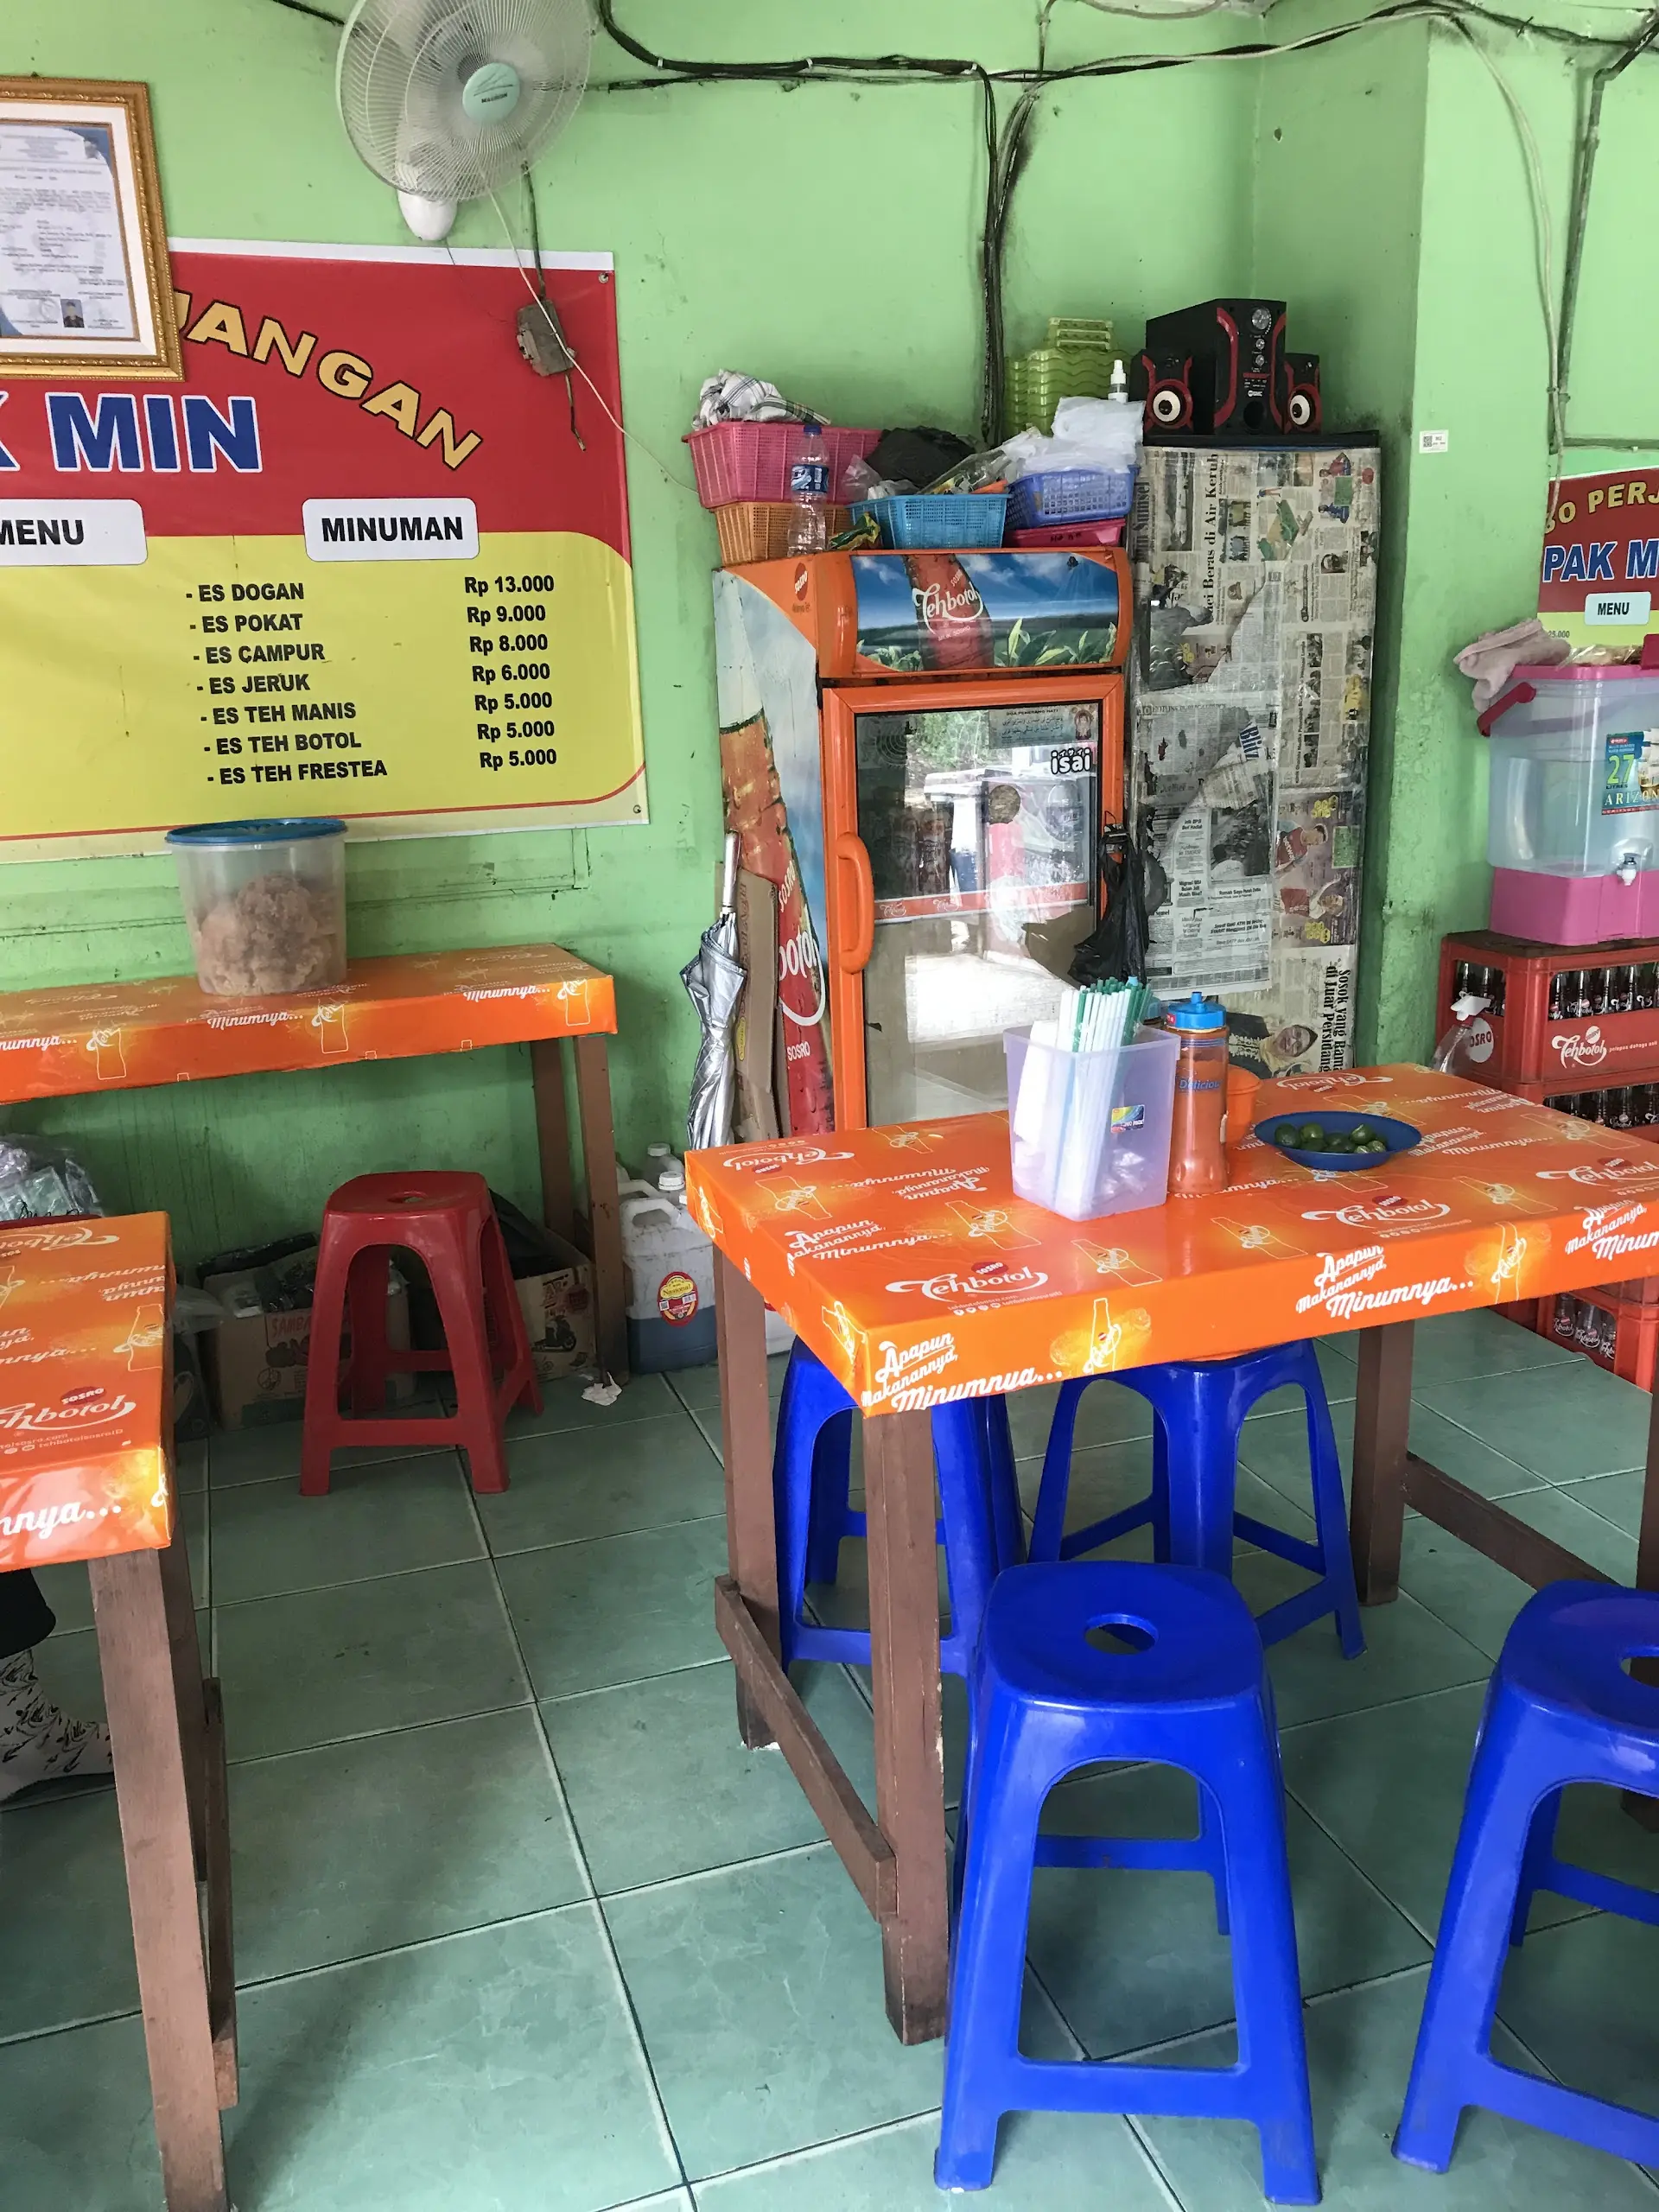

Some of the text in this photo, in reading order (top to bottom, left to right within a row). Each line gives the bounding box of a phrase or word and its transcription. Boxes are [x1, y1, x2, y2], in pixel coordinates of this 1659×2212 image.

[45, 391, 264, 473] MIN
[1205, 453, 1219, 499] Keruh
[1205, 503, 1217, 528] Air
[321, 516, 463, 543] MINUMAN
[1205, 531, 1217, 545] di
[1202, 549, 1216, 590] Beras
[1541, 540, 1618, 583] PAK
[198, 582, 304, 602] ES DOGAN
[466, 575, 555, 596] Rp 13.000
[467, 605, 546, 626] Rp 9.000
[1597, 601, 1630, 616] MENU
[202, 613, 303, 632] ES POKAT
[206, 643, 325, 664] ES CAMPUR
[469, 633, 548, 656] Rp 8.000
[209, 674, 310, 694] ES JERUK
[472, 663, 550, 685] Rp 6.000
[213, 702, 357, 724] ES TEH MANIS
[474, 691, 552, 714] Rp 5.000
[217, 732, 361, 754] ES TEH BOTOL
[477, 721, 555, 742] Rp 5.000
[1239, 726, 1263, 760] Blitz
[480, 748, 556, 771] Rp 5.000
[1051, 747, 1091, 775] isai
[1607, 753, 1635, 785] 27
[219, 760, 387, 784] ES TEH FRESTEA
[1325, 965, 1337, 980] di
[463, 984, 550, 1003] Minumnya...
[1324, 980, 1337, 1011] Luar
[1338, 969, 1352, 1004] Sosok
[207, 1011, 304, 1031] Minumnya...
[787, 1040, 810, 1062] SOSRO
[1470, 1030, 1492, 1048] OSRO
[1551, 1034, 1607, 1069] Tehbotol
[1300, 1198, 1452, 1229] Tehbotol
[785, 1219, 874, 1249] Apapun
[1564, 1202, 1649, 1255] Makanannya,
[812, 1233, 953, 1261] Minumnya...
[1313, 1243, 1385, 1288] Apapun
[885, 1265, 1049, 1303] Tehbotol
[1295, 1258, 1388, 1314] Makanannya,
[1325, 1275, 1475, 1320] Minumnya...
[874, 1332, 955, 1383] Apapun
[60, 1387, 105, 1406] SOSRO
